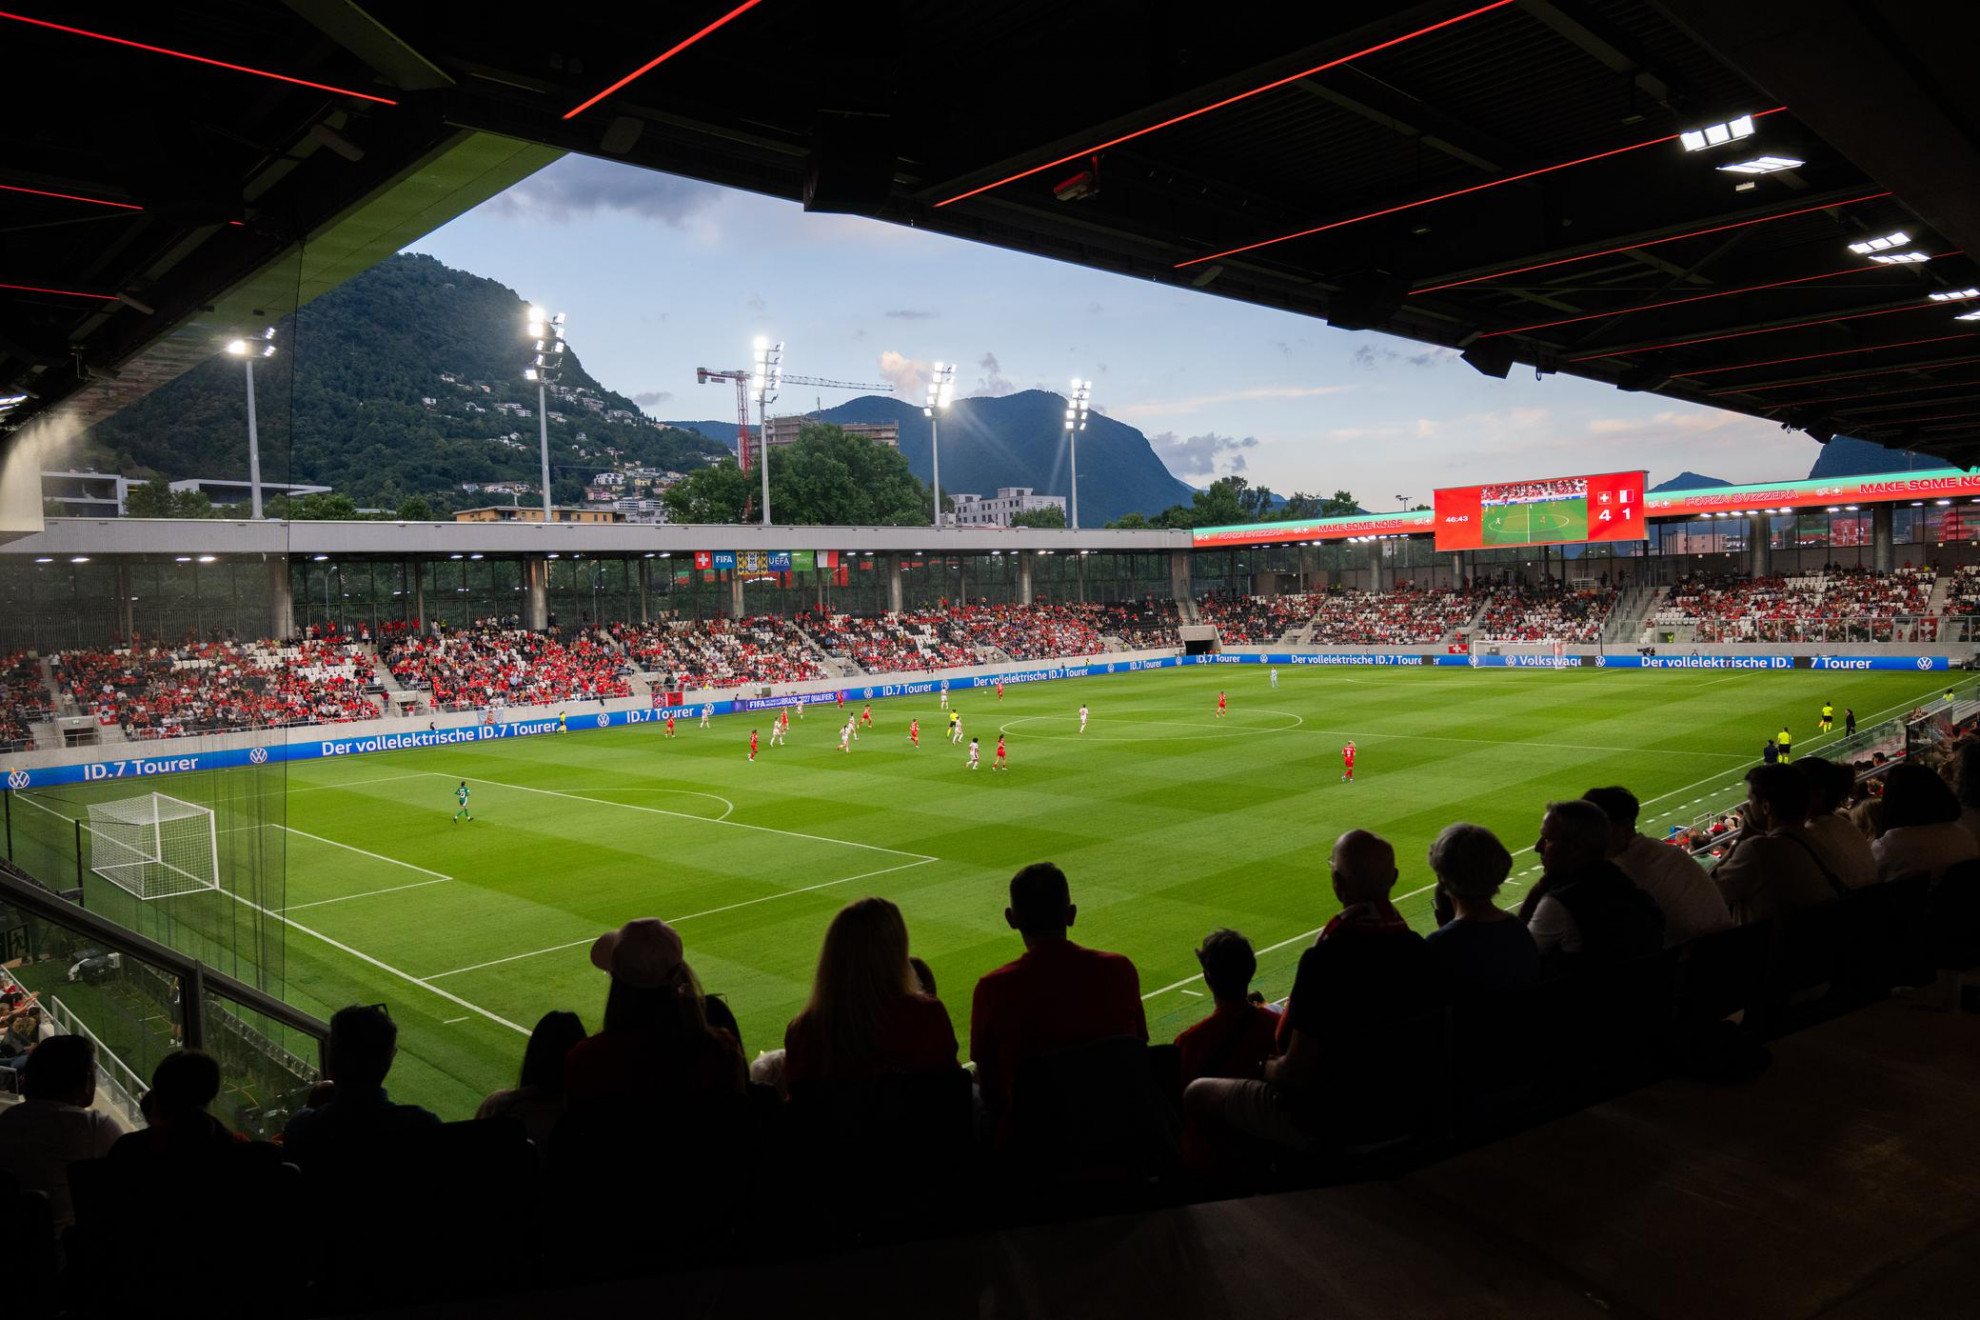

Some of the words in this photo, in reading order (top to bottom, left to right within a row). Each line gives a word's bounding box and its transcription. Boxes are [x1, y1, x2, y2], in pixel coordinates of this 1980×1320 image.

[1859, 481, 1905, 494] MAKE
[1908, 477, 1956, 490] SOME
[1685, 494, 1729, 506] FORZA
[1445, 515, 1469, 523] 46:43
[1598, 509, 1611, 521] 4
[1622, 508, 1631, 520] 1
[1317, 523, 1344, 533] MAKE
[1344, 521, 1373, 531] SOME
[1373, 519, 1403, 529] NOISE
[715, 555, 733, 564] FIFA
[768, 556, 789, 565] UEFA
[1130, 661, 1142, 670] ID.7
[1143, 660, 1162, 669] Tourer
[1215, 654, 1240, 663] Tourer
[1291, 655, 1306, 664] Der
[1308, 655, 1373, 664] vollelektrische
[1375, 655, 1394, 665] ID.7
[1641, 656, 1664, 668] Der
[1666, 656, 1768, 668] vollelektrische
[1822, 657, 1872, 669] Tourer
[1917, 656, 1933, 670] VW
[974, 677, 988, 687] Der
[990, 671, 1047, 685] vollelektrische
[1048, 668, 1064, 679] ID.7
[1065, 667, 1088, 677] Tourer
[882, 685, 901, 697] ID.7
[902, 682, 932, 694] Tourer
[749, 700, 766, 709] FIFA
[626, 709, 652, 723] ID.7
[654, 707, 694, 720] Tourer
[322, 740, 353, 756] Der
[356, 727, 475, 753] vollelektrische
[478, 725, 507, 740] ID.7
[510, 722, 557, 737] Tourer
[250, 747, 268, 763] VW
[84, 762, 126, 781] ID.7
[132, 758, 199, 776] Tourer
[8, 770, 30, 789] VW
